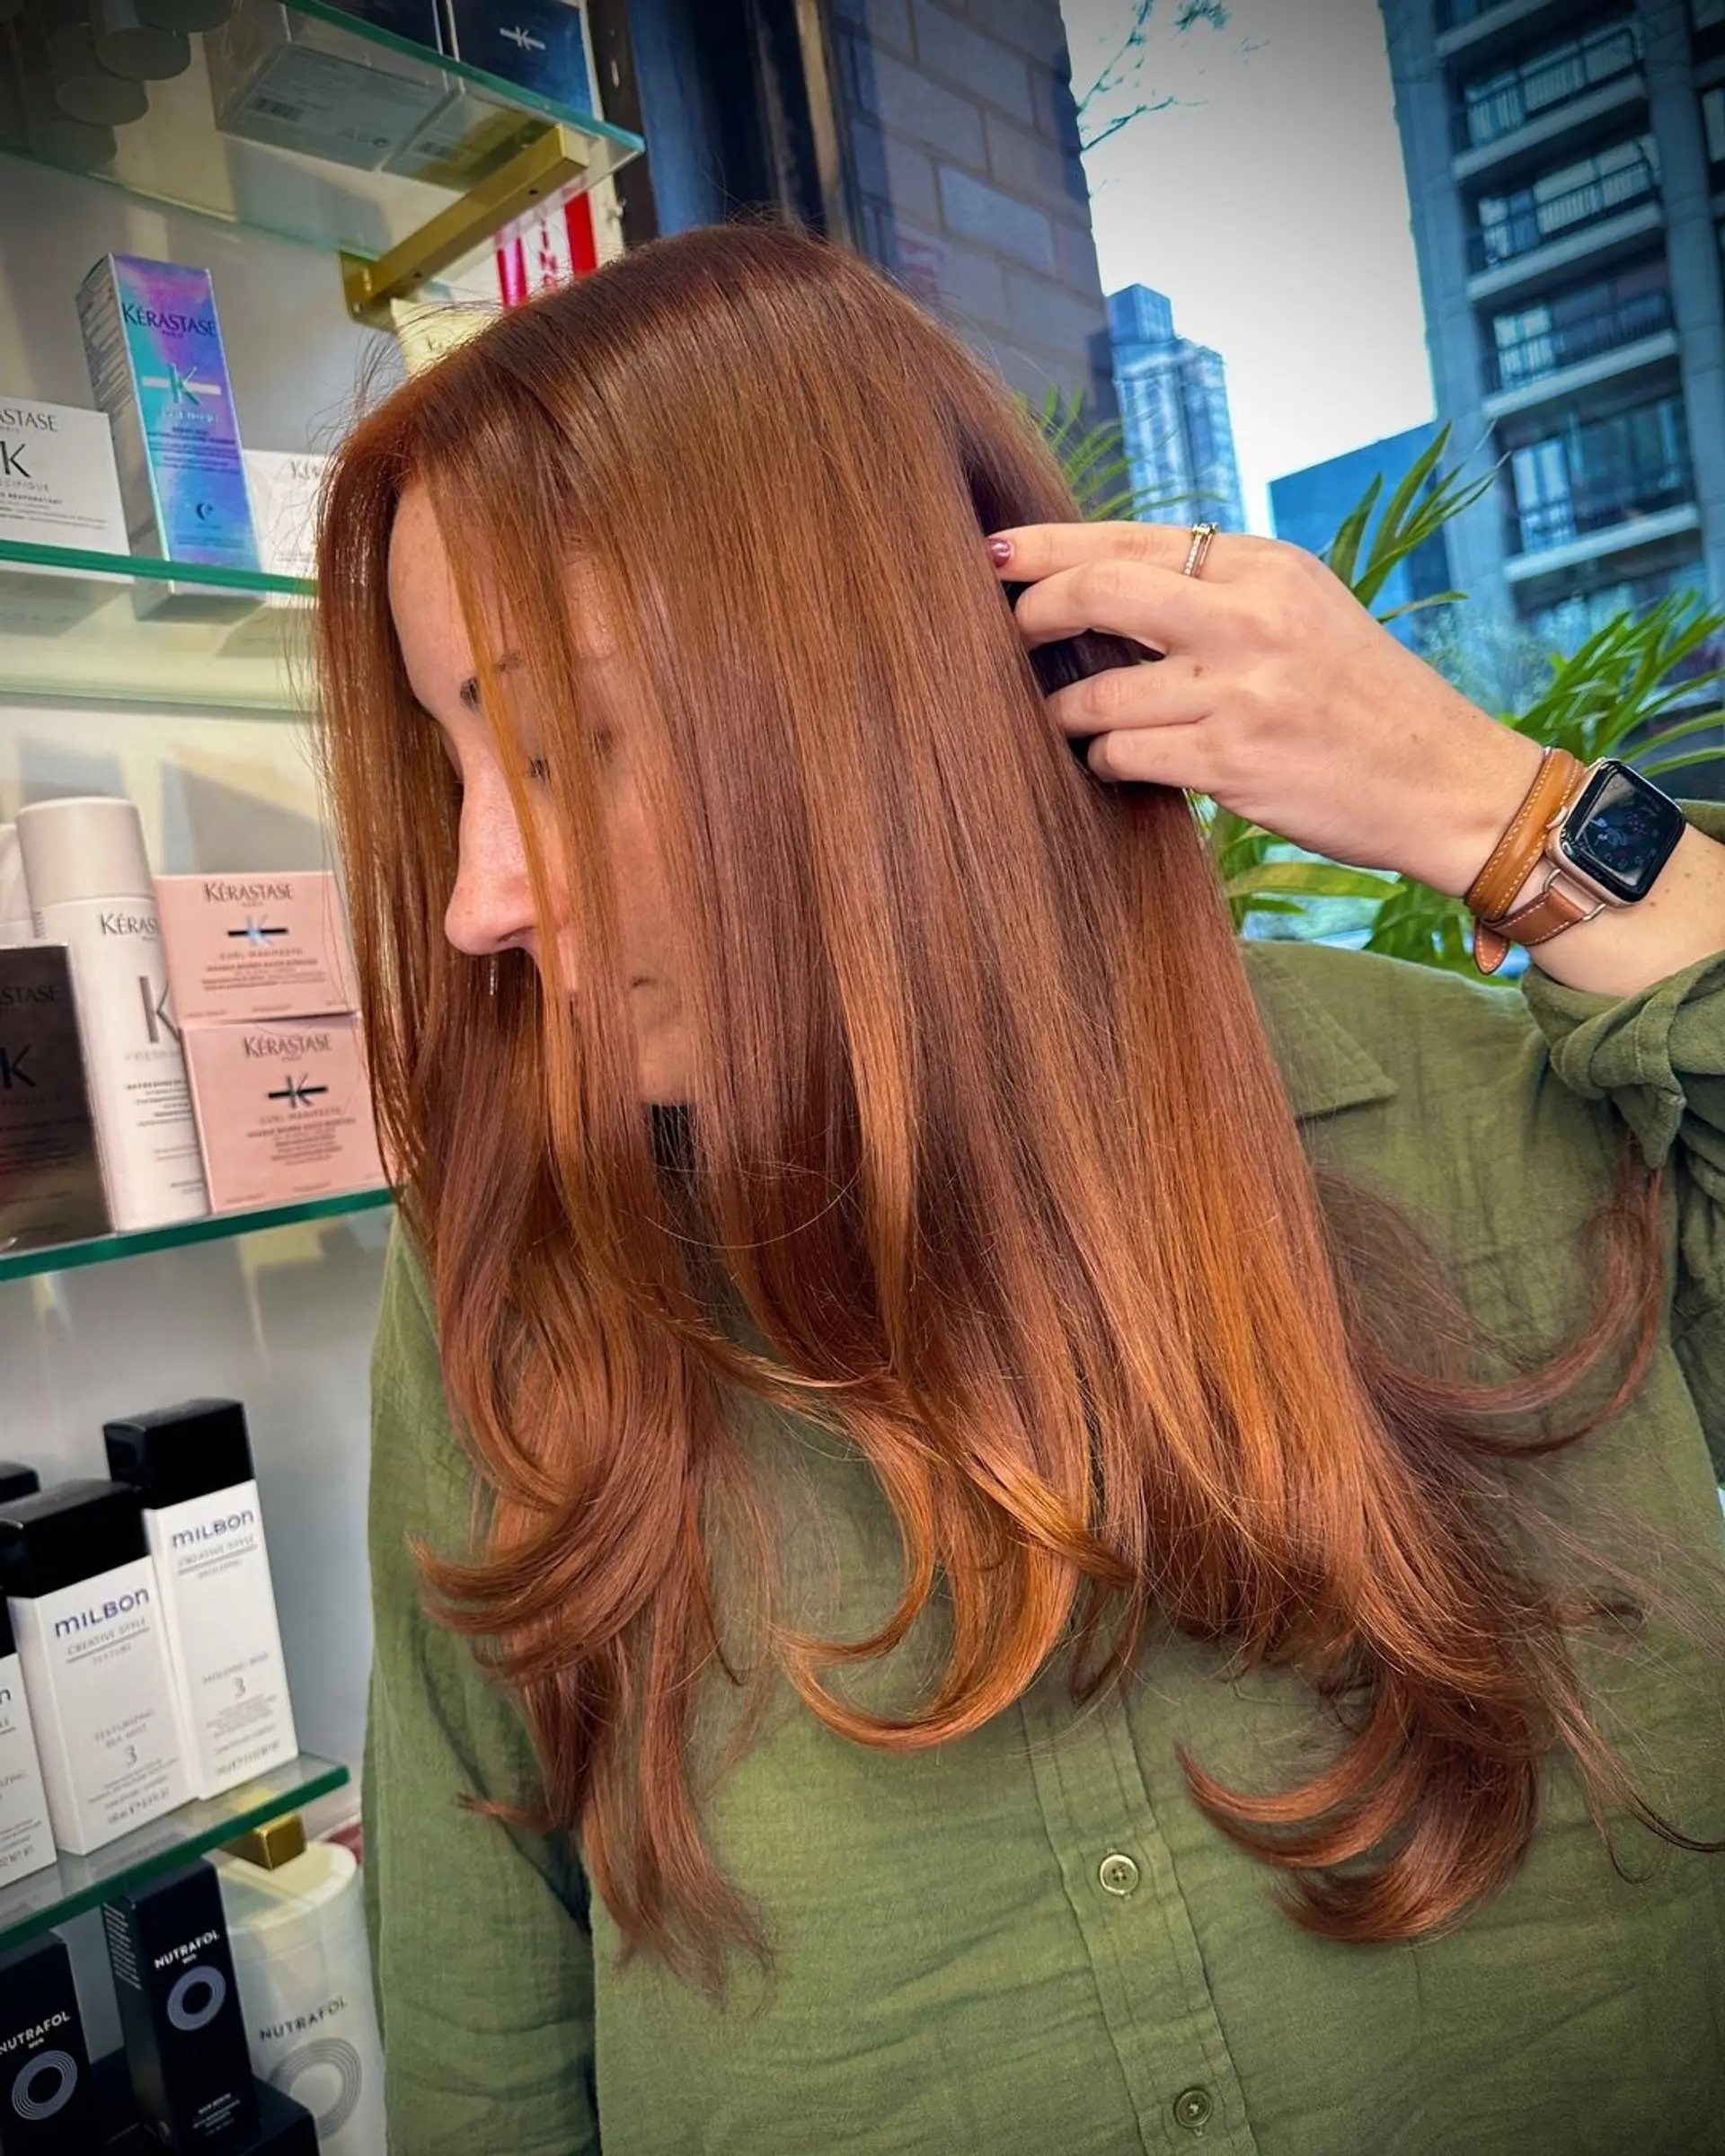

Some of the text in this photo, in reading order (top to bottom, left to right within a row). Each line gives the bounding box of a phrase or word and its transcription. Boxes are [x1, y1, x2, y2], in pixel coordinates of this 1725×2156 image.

[122, 301, 217, 338] KÉRASTASE
[205, 881, 294, 902] KÉRASTASE
[244, 1035, 332, 1058] KÉRASTASE
[155, 1929, 221, 1970] NUTRAFOL
[0, 2010, 71, 2055] NUTRAFOL
[260, 1995, 348, 2041] NUTRAFOL
